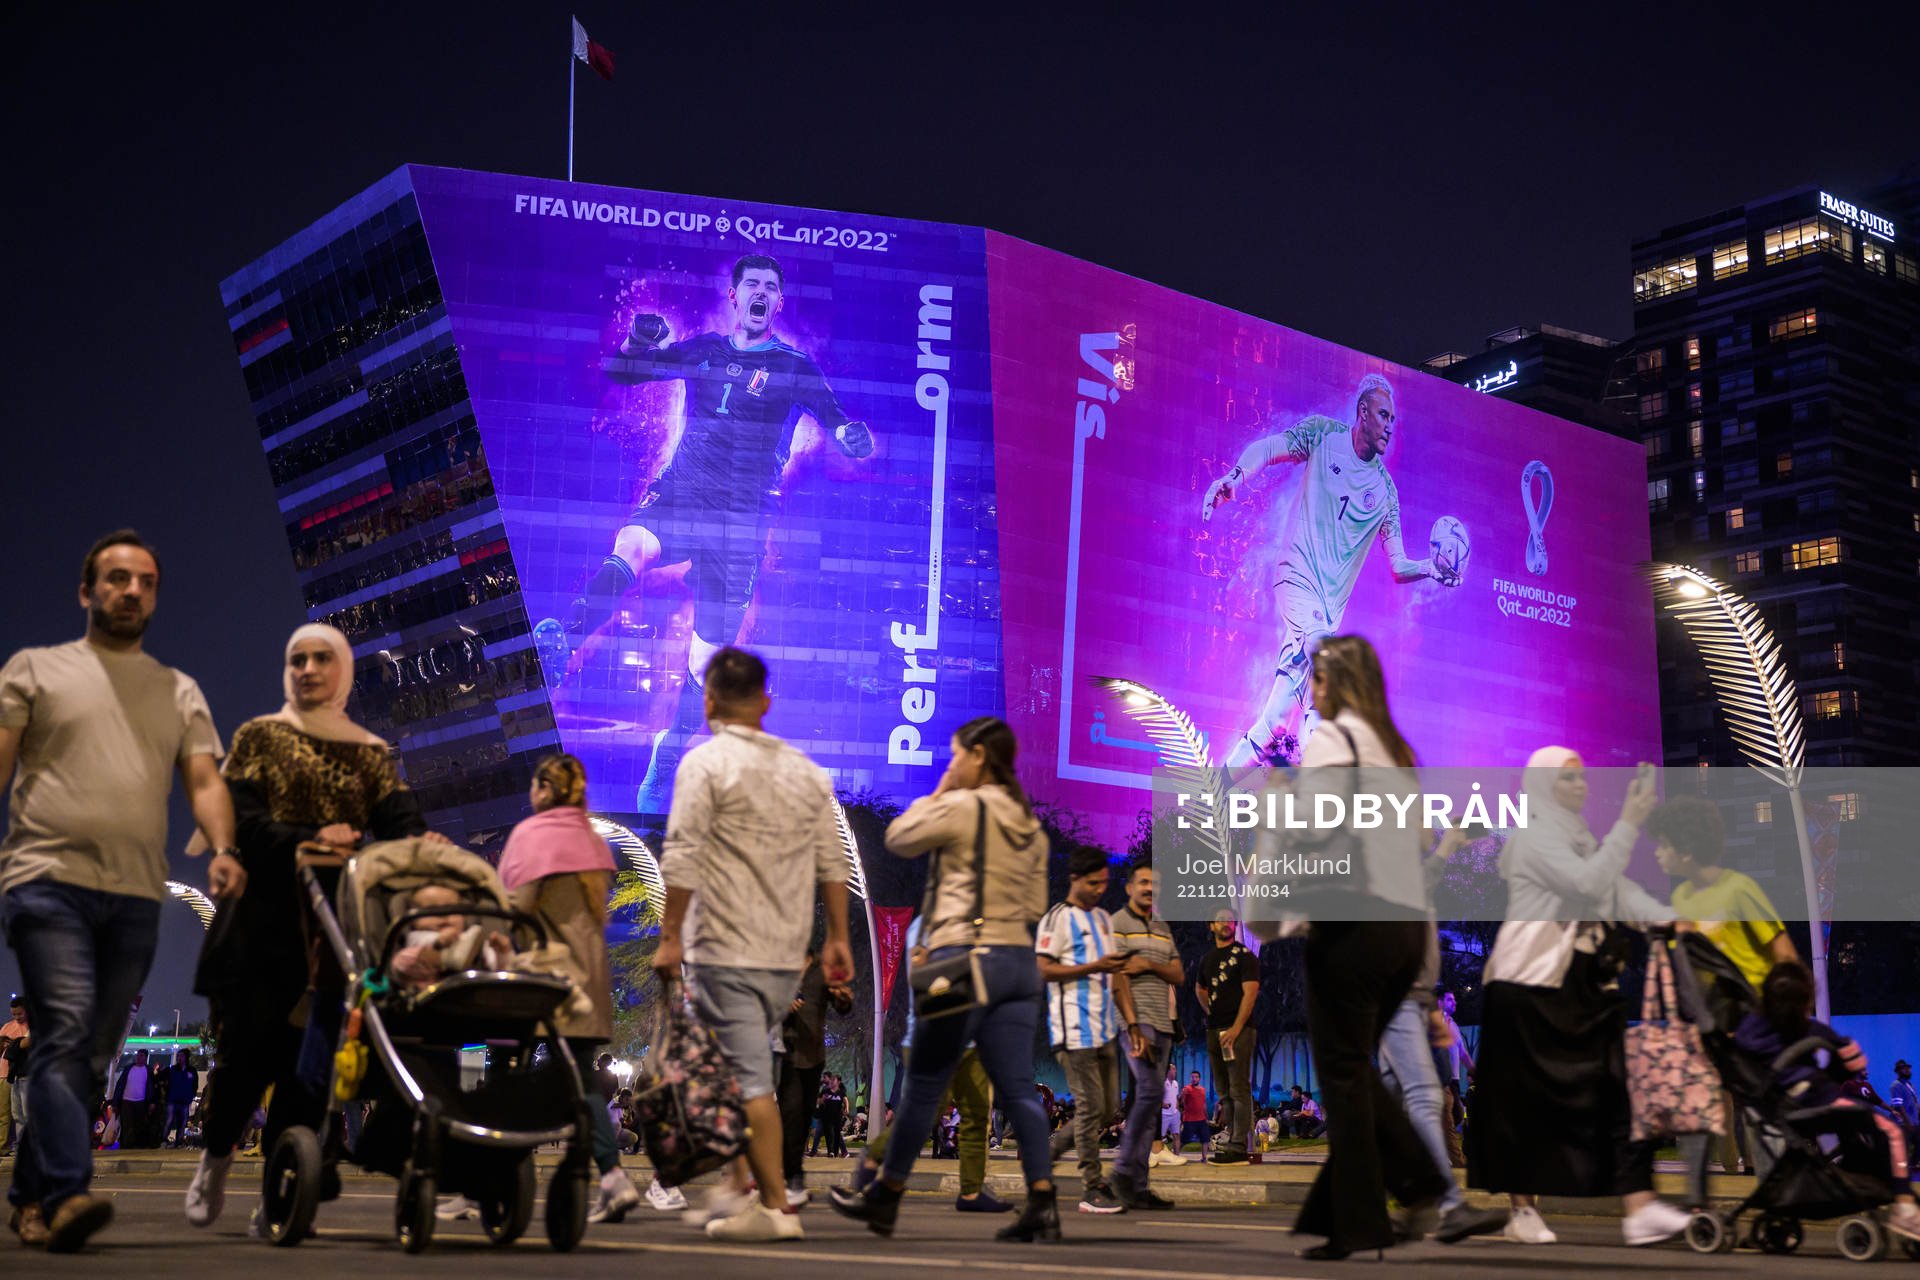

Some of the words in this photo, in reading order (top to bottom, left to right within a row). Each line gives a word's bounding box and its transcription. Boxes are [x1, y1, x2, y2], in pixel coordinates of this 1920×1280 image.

[515, 194, 569, 218] FIFA
[572, 200, 661, 228] WORLD
[663, 211, 711, 232] CUP
[1820, 191, 1860, 221] FRASER
[1860, 209, 1895, 237] SUITES
[716, 382, 733, 415] 1
[1338, 496, 1349, 520] 7
[1493, 578, 1517, 596] FIFA
[1517, 584, 1555, 605] WORLD
[1556, 594, 1577, 610] CUP
